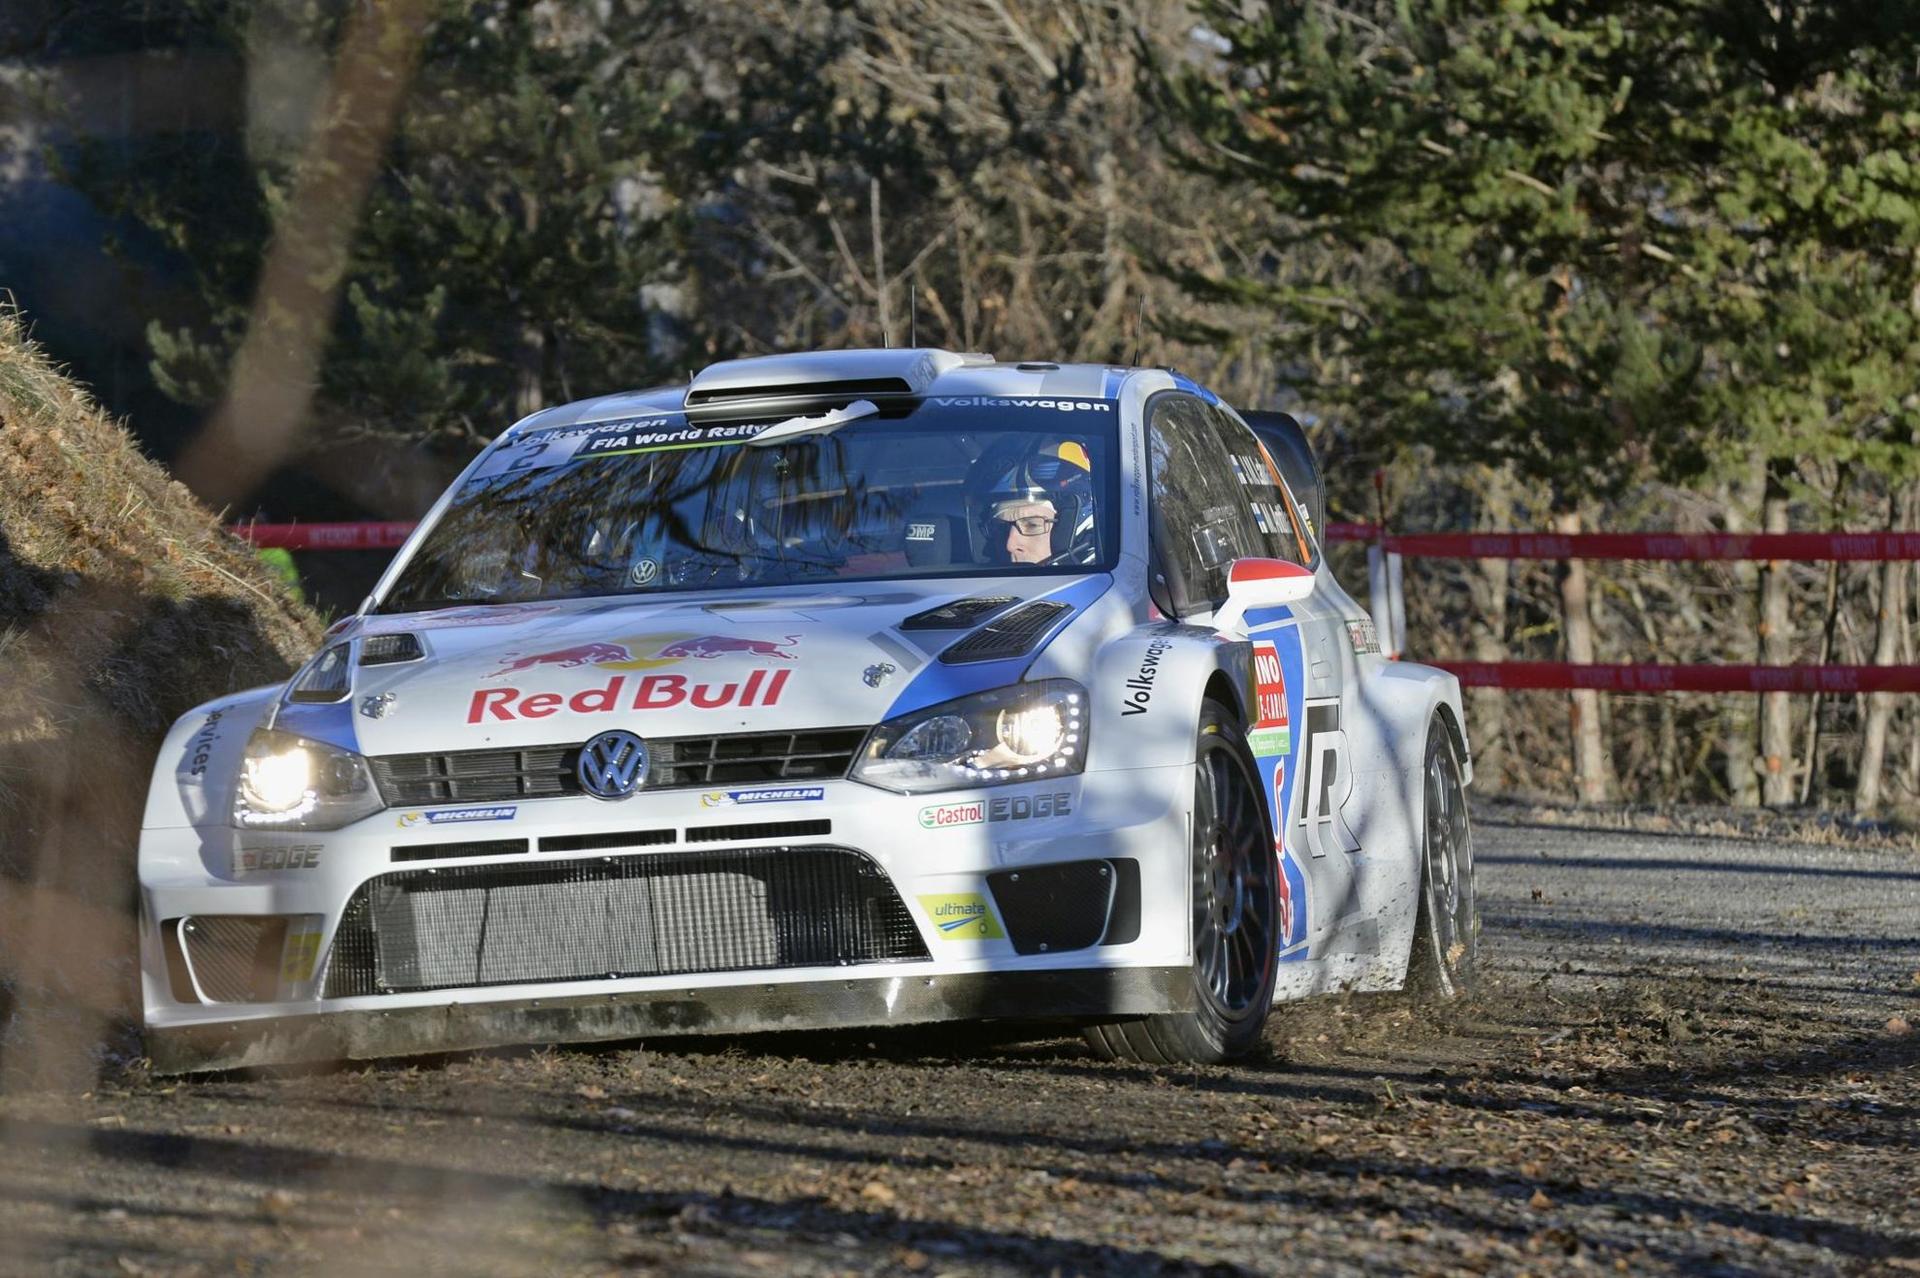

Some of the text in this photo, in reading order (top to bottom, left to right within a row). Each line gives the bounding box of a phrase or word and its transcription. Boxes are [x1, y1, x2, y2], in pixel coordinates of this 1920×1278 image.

[931, 396, 1110, 412] Volkswagen
[511, 418, 668, 447] Volkswagen
[591, 424, 769, 450] FIA World Rally
[507, 443, 549, 471] 2
[1121, 636, 1173, 716] Volkswag
[467, 669, 791, 724] Red Bull
[737, 789, 822, 800] MICHELIN
[431, 808, 515, 821] MICHELIN
[936, 793, 1072, 825] Castrol EDGE
[259, 844, 325, 871] EDGE
[935, 902, 985, 916] ultimate
